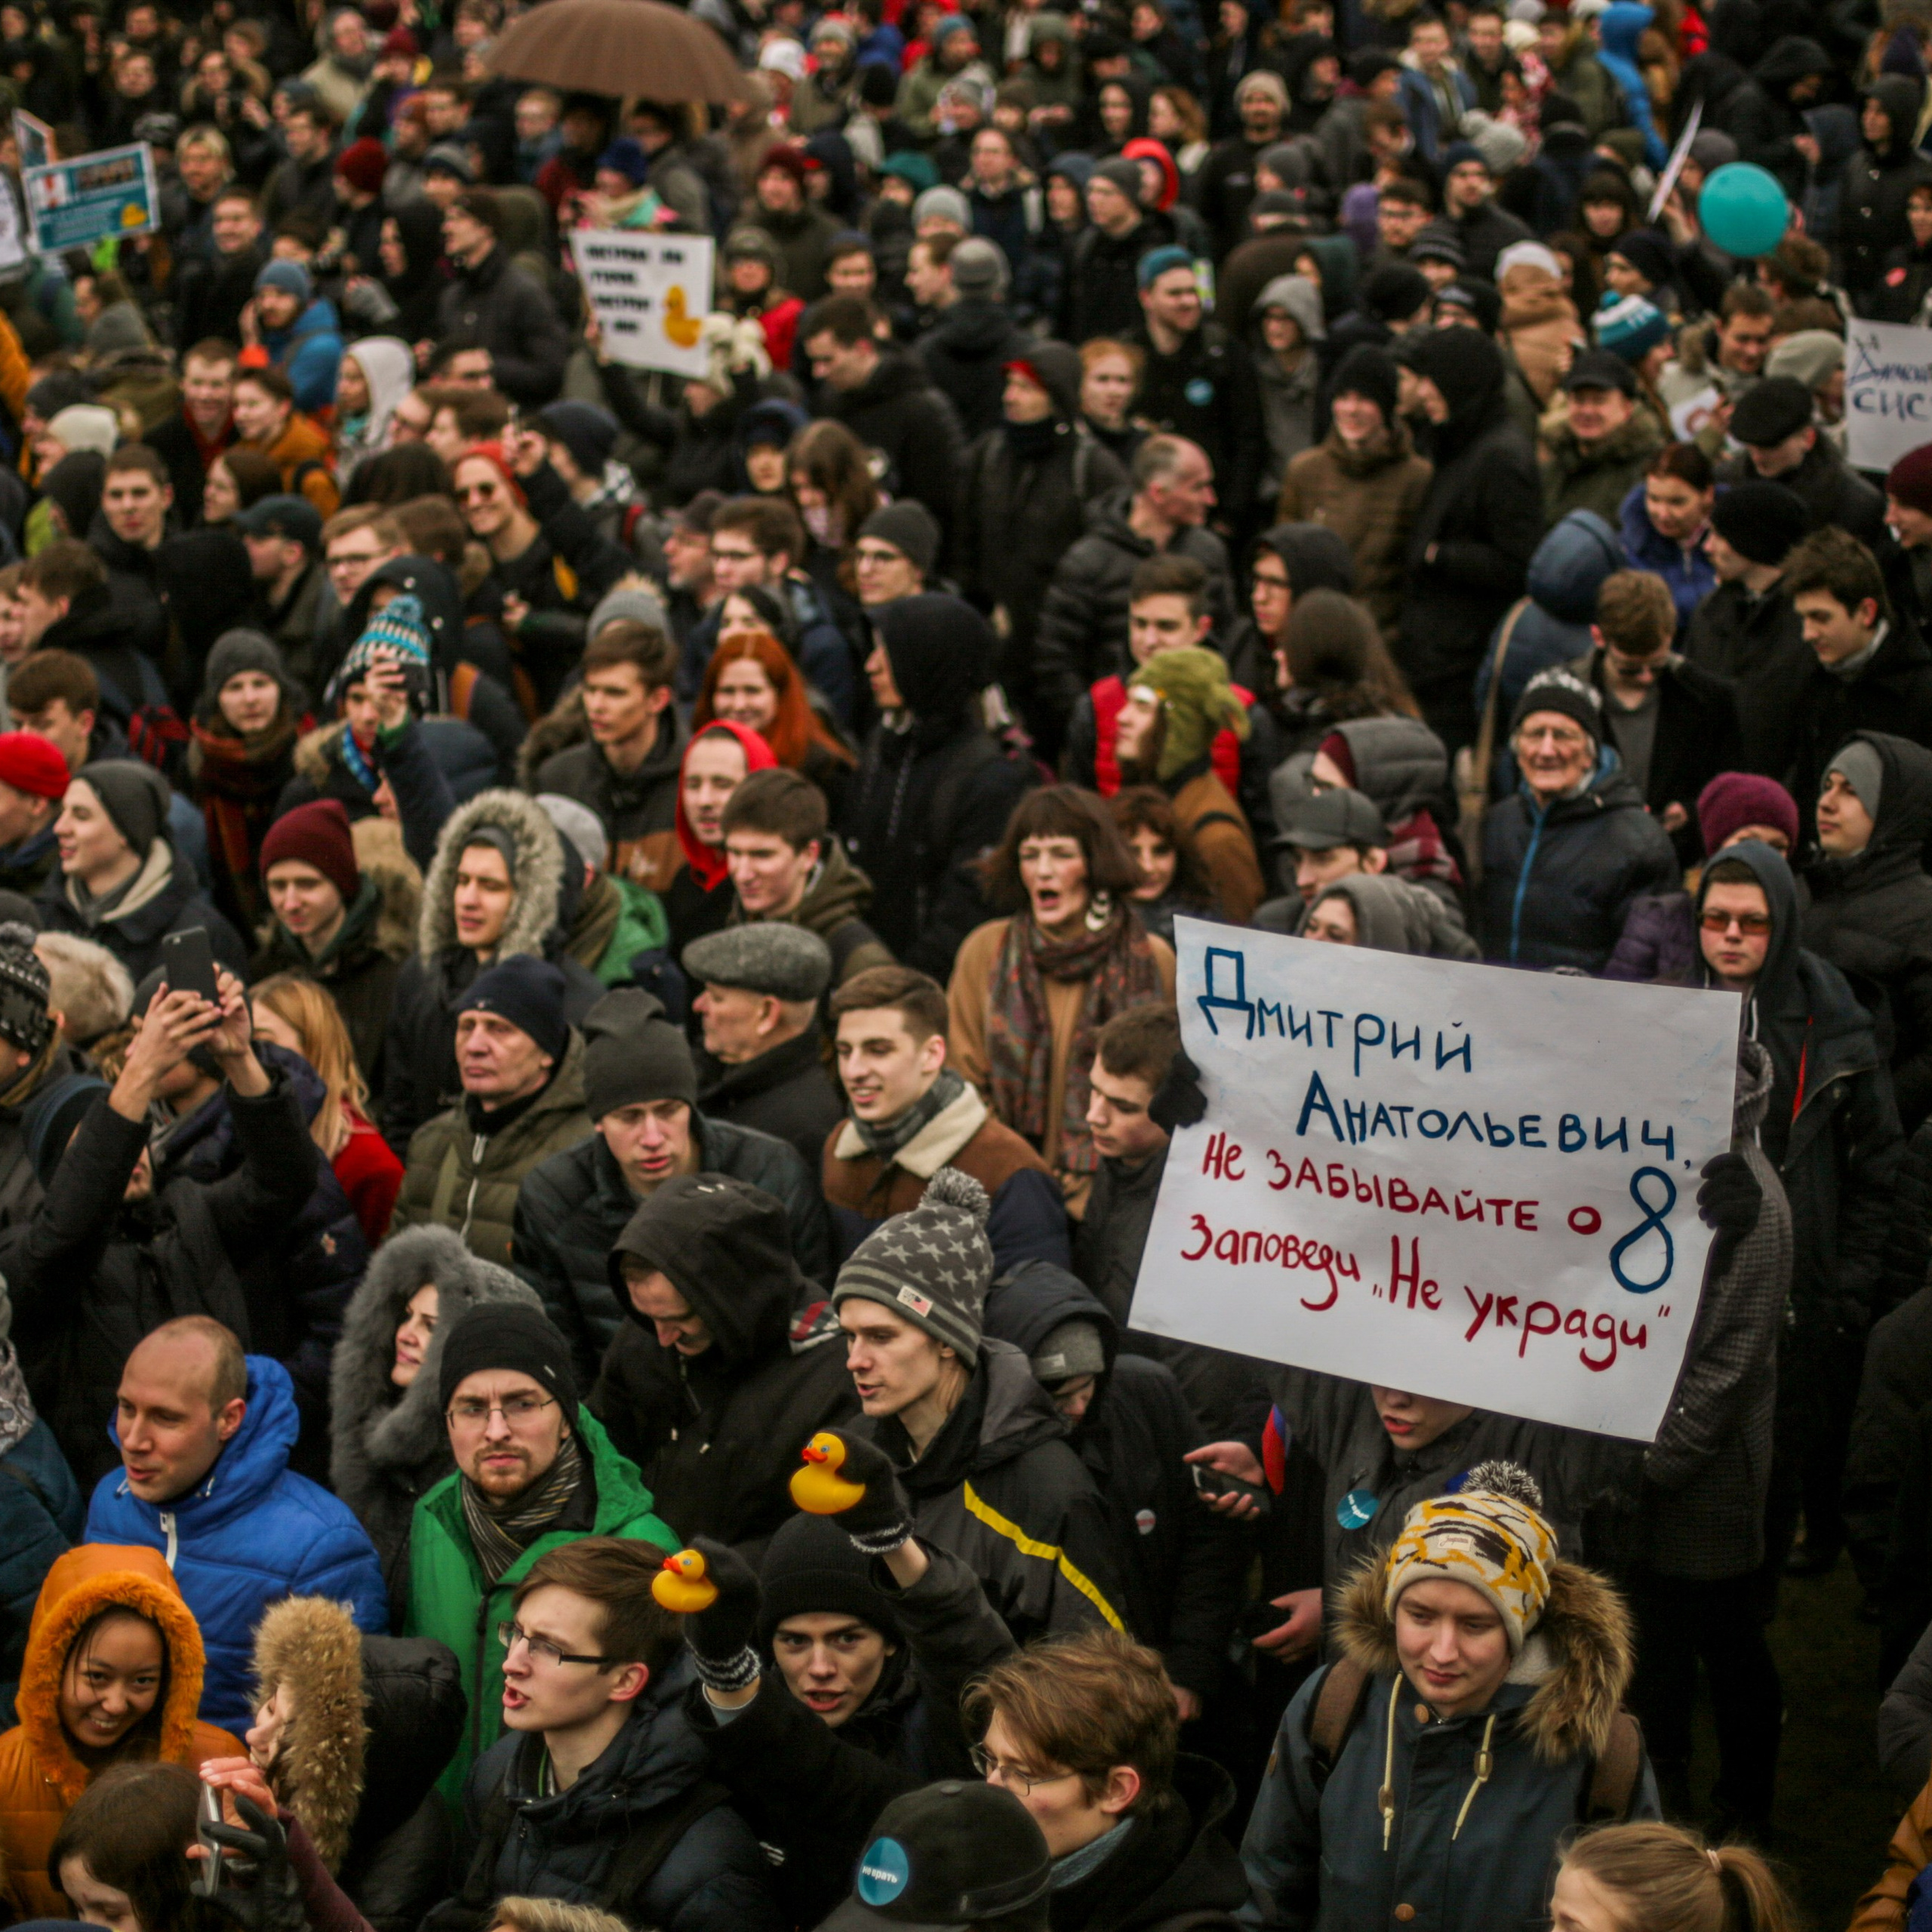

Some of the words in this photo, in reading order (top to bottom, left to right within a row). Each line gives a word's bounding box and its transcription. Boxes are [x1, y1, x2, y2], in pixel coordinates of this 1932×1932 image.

[1197, 946, 1472, 1077] Дмитрий
[1180, 1214, 1361, 1312] Заповеди
[1201, 1132, 1245, 1182] Не
[1610, 1166, 1677, 1294] 8
[871, 1869, 898, 1883] врать
